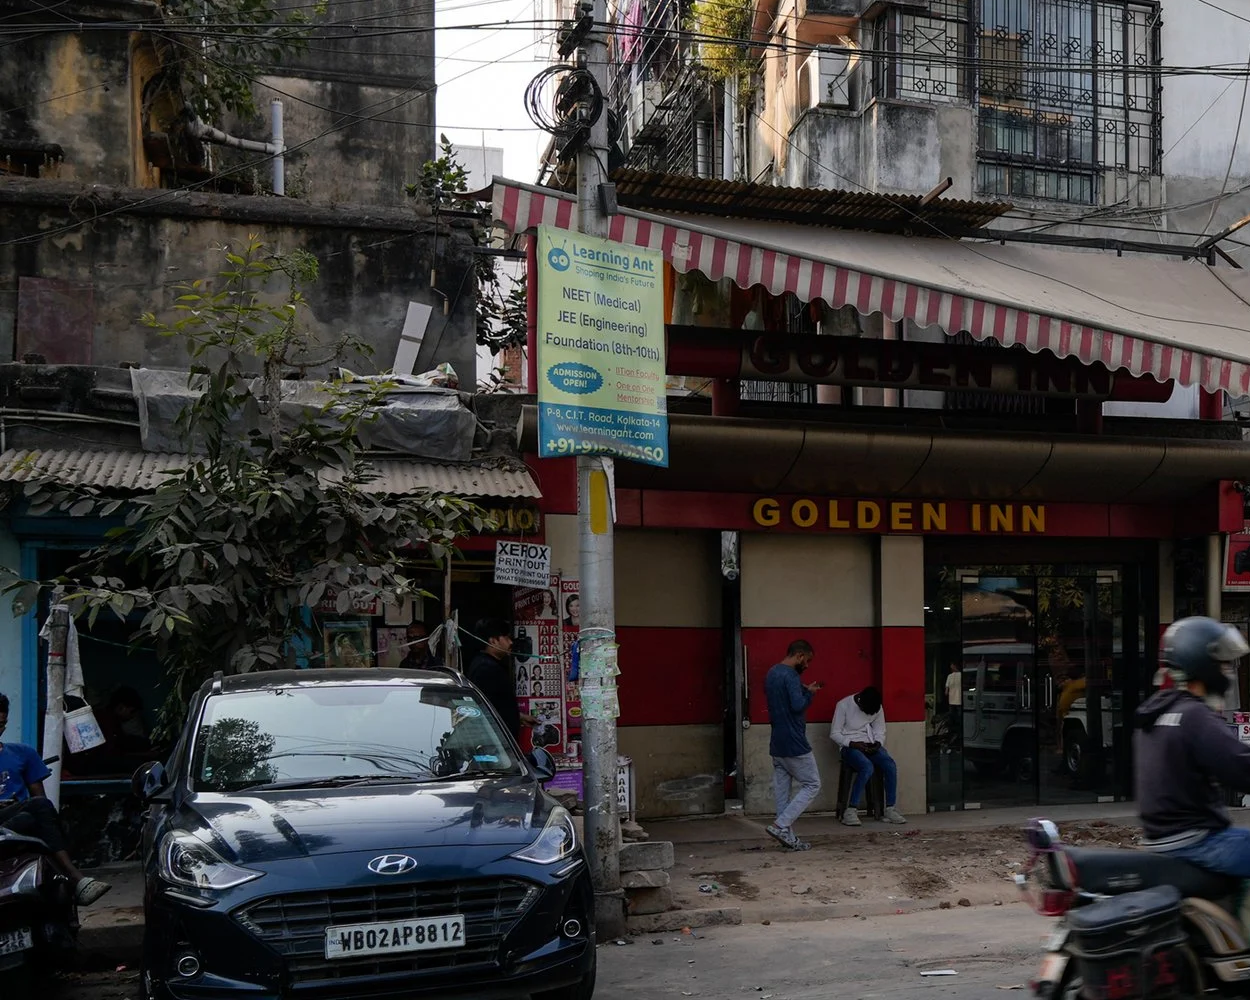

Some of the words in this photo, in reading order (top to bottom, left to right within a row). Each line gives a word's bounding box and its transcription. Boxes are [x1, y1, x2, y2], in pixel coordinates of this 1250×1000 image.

[573, 243, 630, 270] Learning
[633, 256, 655, 272] Ant
[575, 266, 605, 281] Shaping
[606, 272, 630, 285] India's
[631, 278, 655, 289] Future
[563, 287, 591, 303] NEET
[594, 292, 641, 313] (Medical)
[557, 310, 577, 325] JEE
[580, 312, 648, 338] (Engineering)
[545, 332, 610, 353] Foundation
[612, 341, 660, 361] (8th-10th)
[553, 368, 598, 380] ADMISSION
[751, 336, 993, 389] GOLDEN
[563, 378, 588, 388] OPEN!
[546, 408, 564, 420] P-8,
[565, 410, 587, 422] C.I.T.
[588, 412, 614, 425] Road,
[617, 415, 660, 428] Kolkata-14
[557, 422, 654, 441] www.learningant.com
[752, 497, 948, 531] GOLDEN
[971, 504, 1046, 533] INN
[498, 542, 548, 560] XEROX
[496, 567, 520, 575] PHOTO
[340, 922, 462, 952] WB02AP8812
